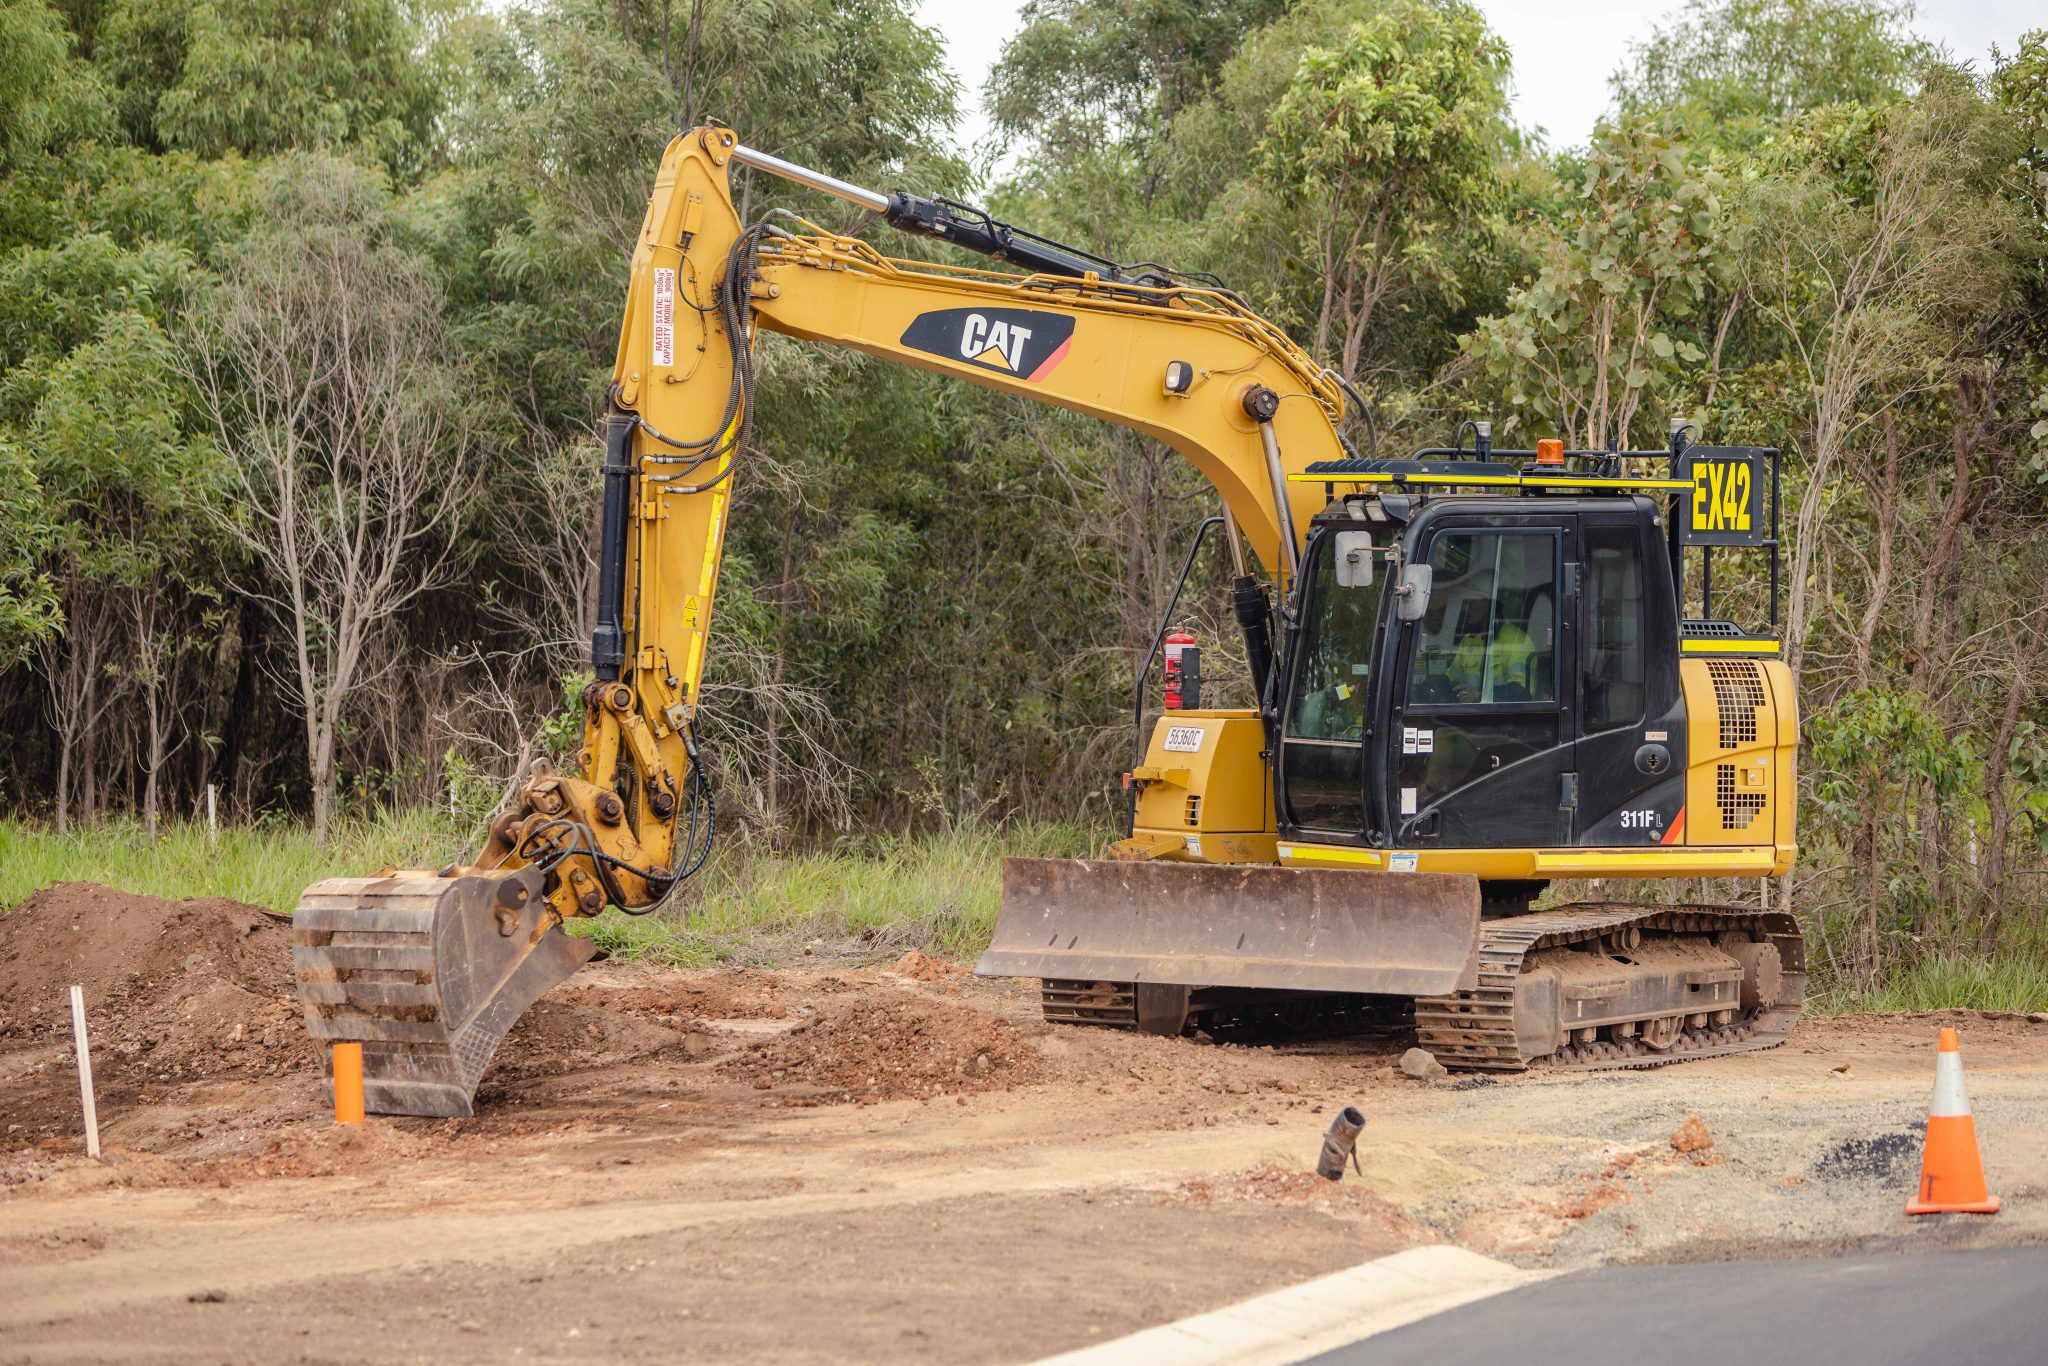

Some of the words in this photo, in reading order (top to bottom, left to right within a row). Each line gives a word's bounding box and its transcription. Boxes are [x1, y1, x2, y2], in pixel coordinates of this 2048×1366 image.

[655, 296, 664, 324] STATIC:
[664, 296, 672, 324] MOBILE:
[655, 326, 663, 352] RATED
[663, 327, 671, 365] CAPACITY
[960, 313, 1032, 372] CAT
[1693, 462, 1751, 531] EX42
[1168, 728, 1201, 746] 56360C
[1620, 809, 1654, 828] 311F
